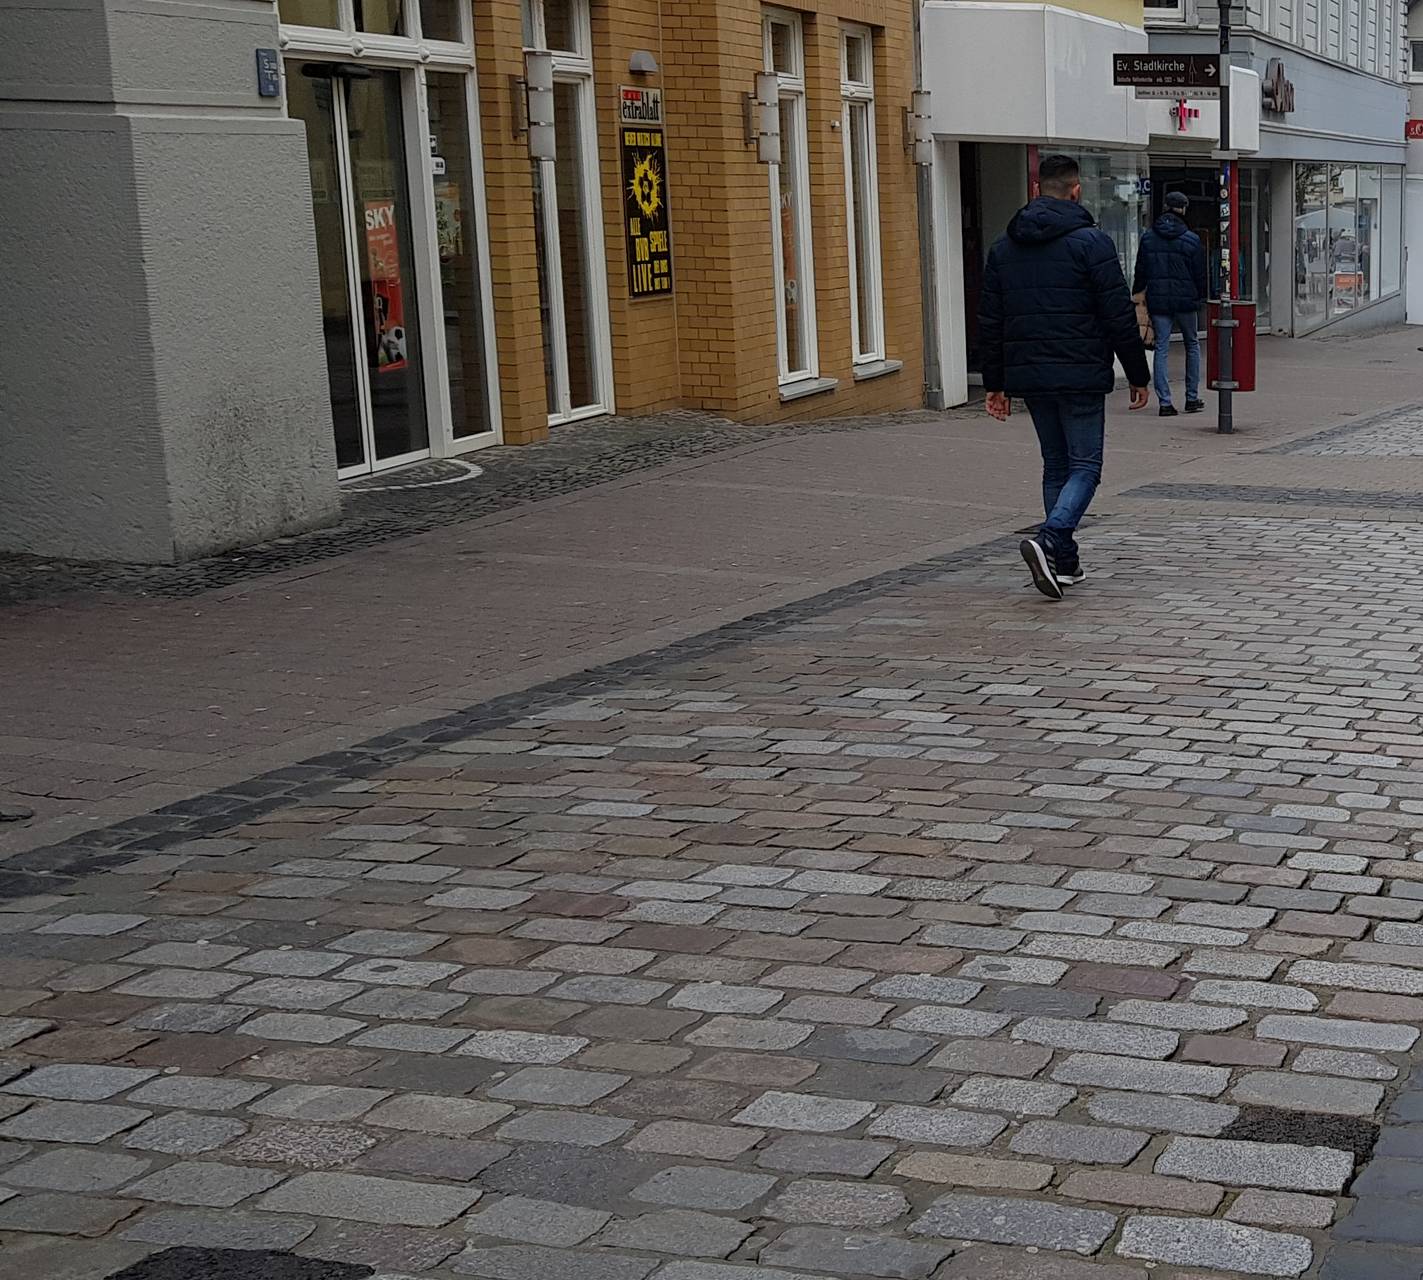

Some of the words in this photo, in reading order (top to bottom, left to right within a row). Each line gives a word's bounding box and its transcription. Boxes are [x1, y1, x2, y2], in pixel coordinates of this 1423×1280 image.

[1116, 60, 1130, 71] Ev.
[1133, 60, 1185, 71] Stadtkirche
[622, 91, 660, 120] extrablatt
[365, 204, 395, 231] SKY
[632, 263, 654, 293] LIVE
